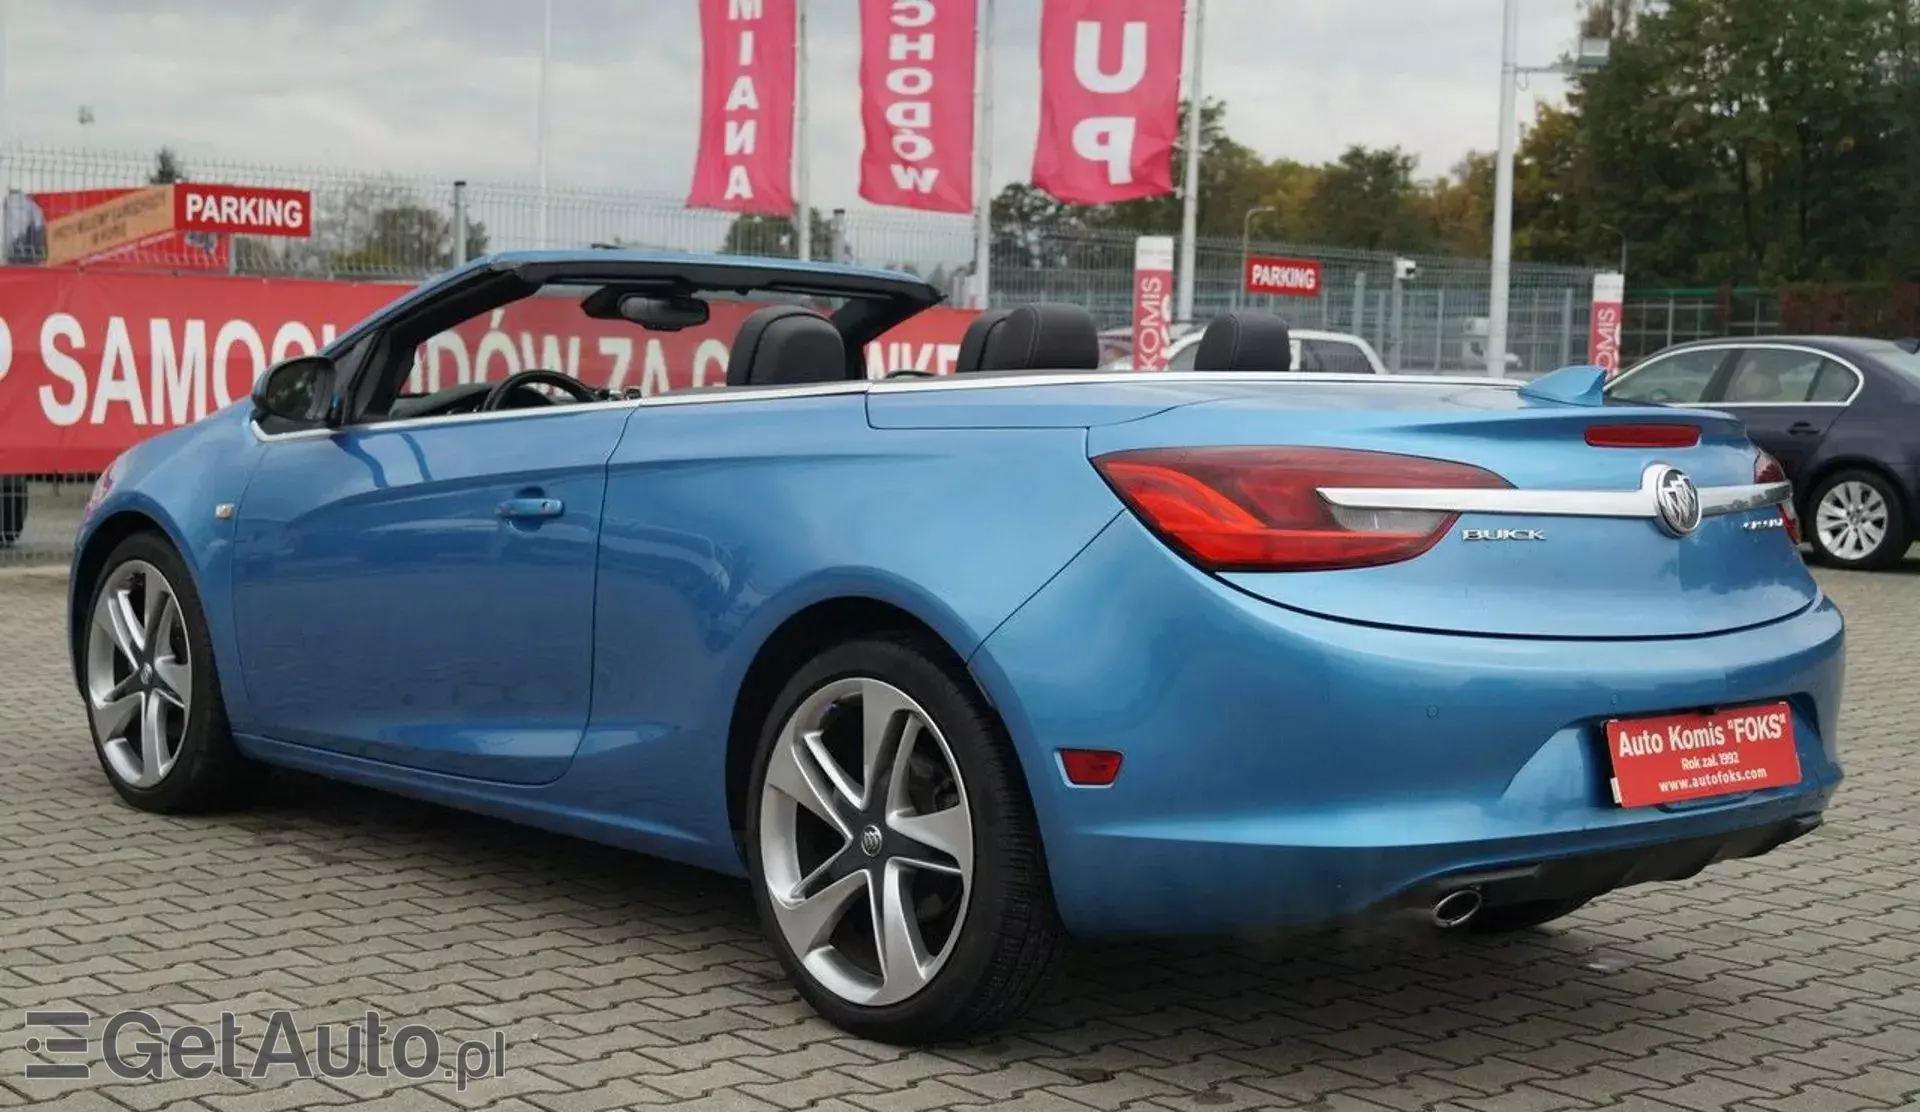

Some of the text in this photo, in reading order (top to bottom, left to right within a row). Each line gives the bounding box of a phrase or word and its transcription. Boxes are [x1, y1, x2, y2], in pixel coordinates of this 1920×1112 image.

[186, 193, 304, 228] PARKING
[1251, 264, 1317, 290] PARKING
[1139, 276, 1162, 371] KOMIS
[1595, 306, 1616, 376] OMIS
[1461, 529, 1547, 541] BUICK
[1619, 731, 1664, 758] Auto
[1668, 723, 1725, 751] Komis
[1681, 757, 1701, 771] Rok
[1719, 751, 1740, 766] 1992
[1658, 767, 1768, 793] www.autofoks.com
